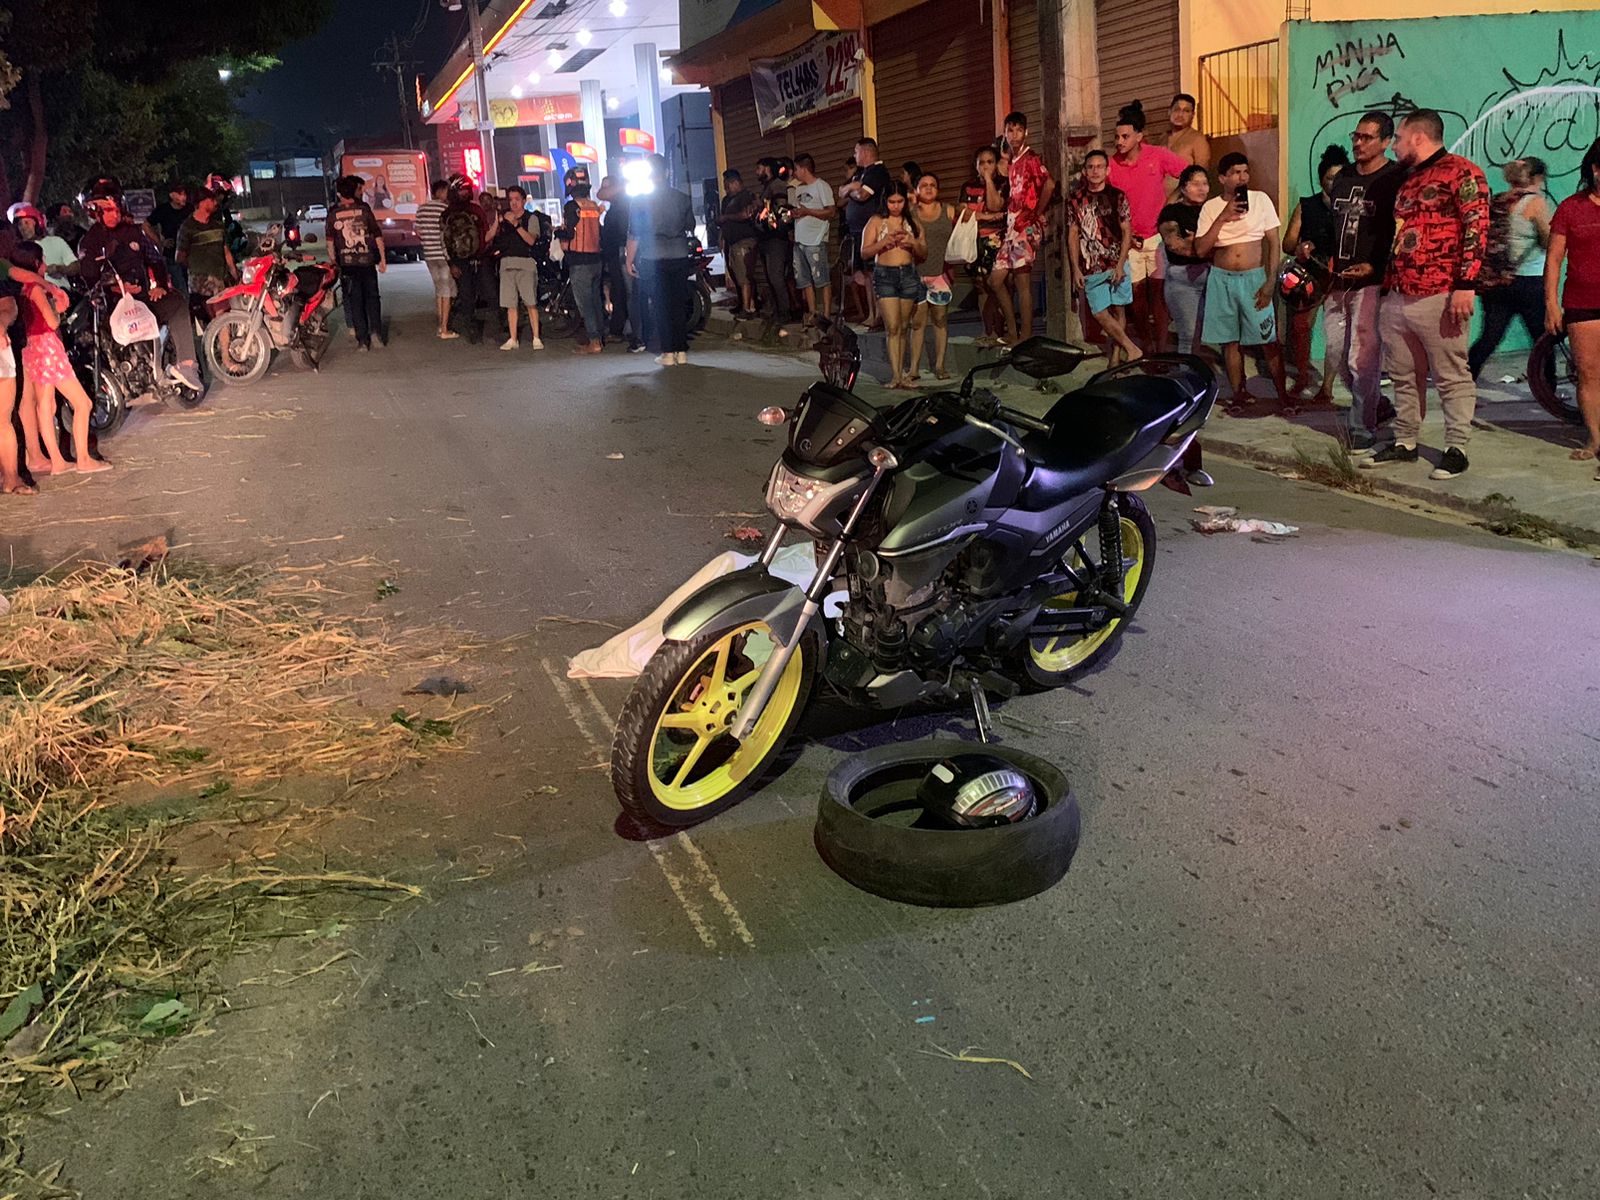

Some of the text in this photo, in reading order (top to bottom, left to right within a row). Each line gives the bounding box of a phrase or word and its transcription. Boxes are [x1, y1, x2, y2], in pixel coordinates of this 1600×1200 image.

[776, 58, 820, 102] TELHAS
[1312, 31, 1405, 90] MINHA
[1045, 520, 1070, 543] YAMAHA
